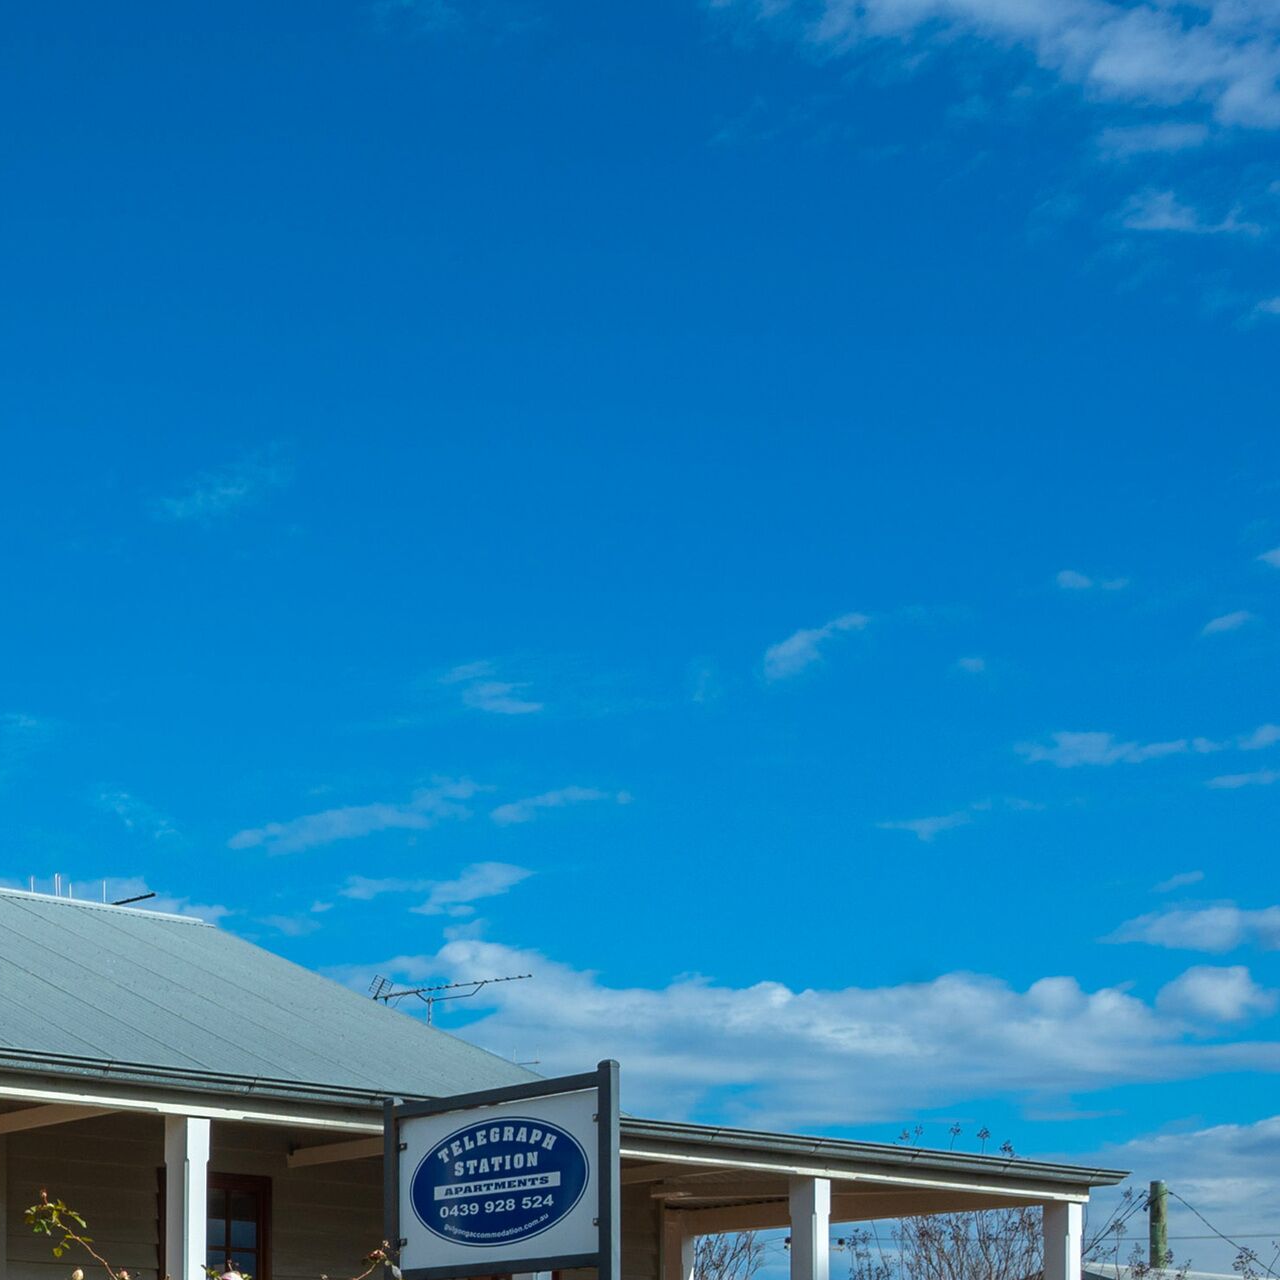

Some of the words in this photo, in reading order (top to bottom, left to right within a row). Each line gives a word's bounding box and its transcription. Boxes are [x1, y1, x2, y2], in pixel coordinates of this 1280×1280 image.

[438, 1126, 557, 1164] TELEGRAPH
[454, 1151, 539, 1177] STATION
[444, 1175, 549, 1197] APARTMENTS
[440, 1202, 479, 1218] 0439
[485, 1199, 516, 1213] 928
[522, 1194, 554, 1209] 524
